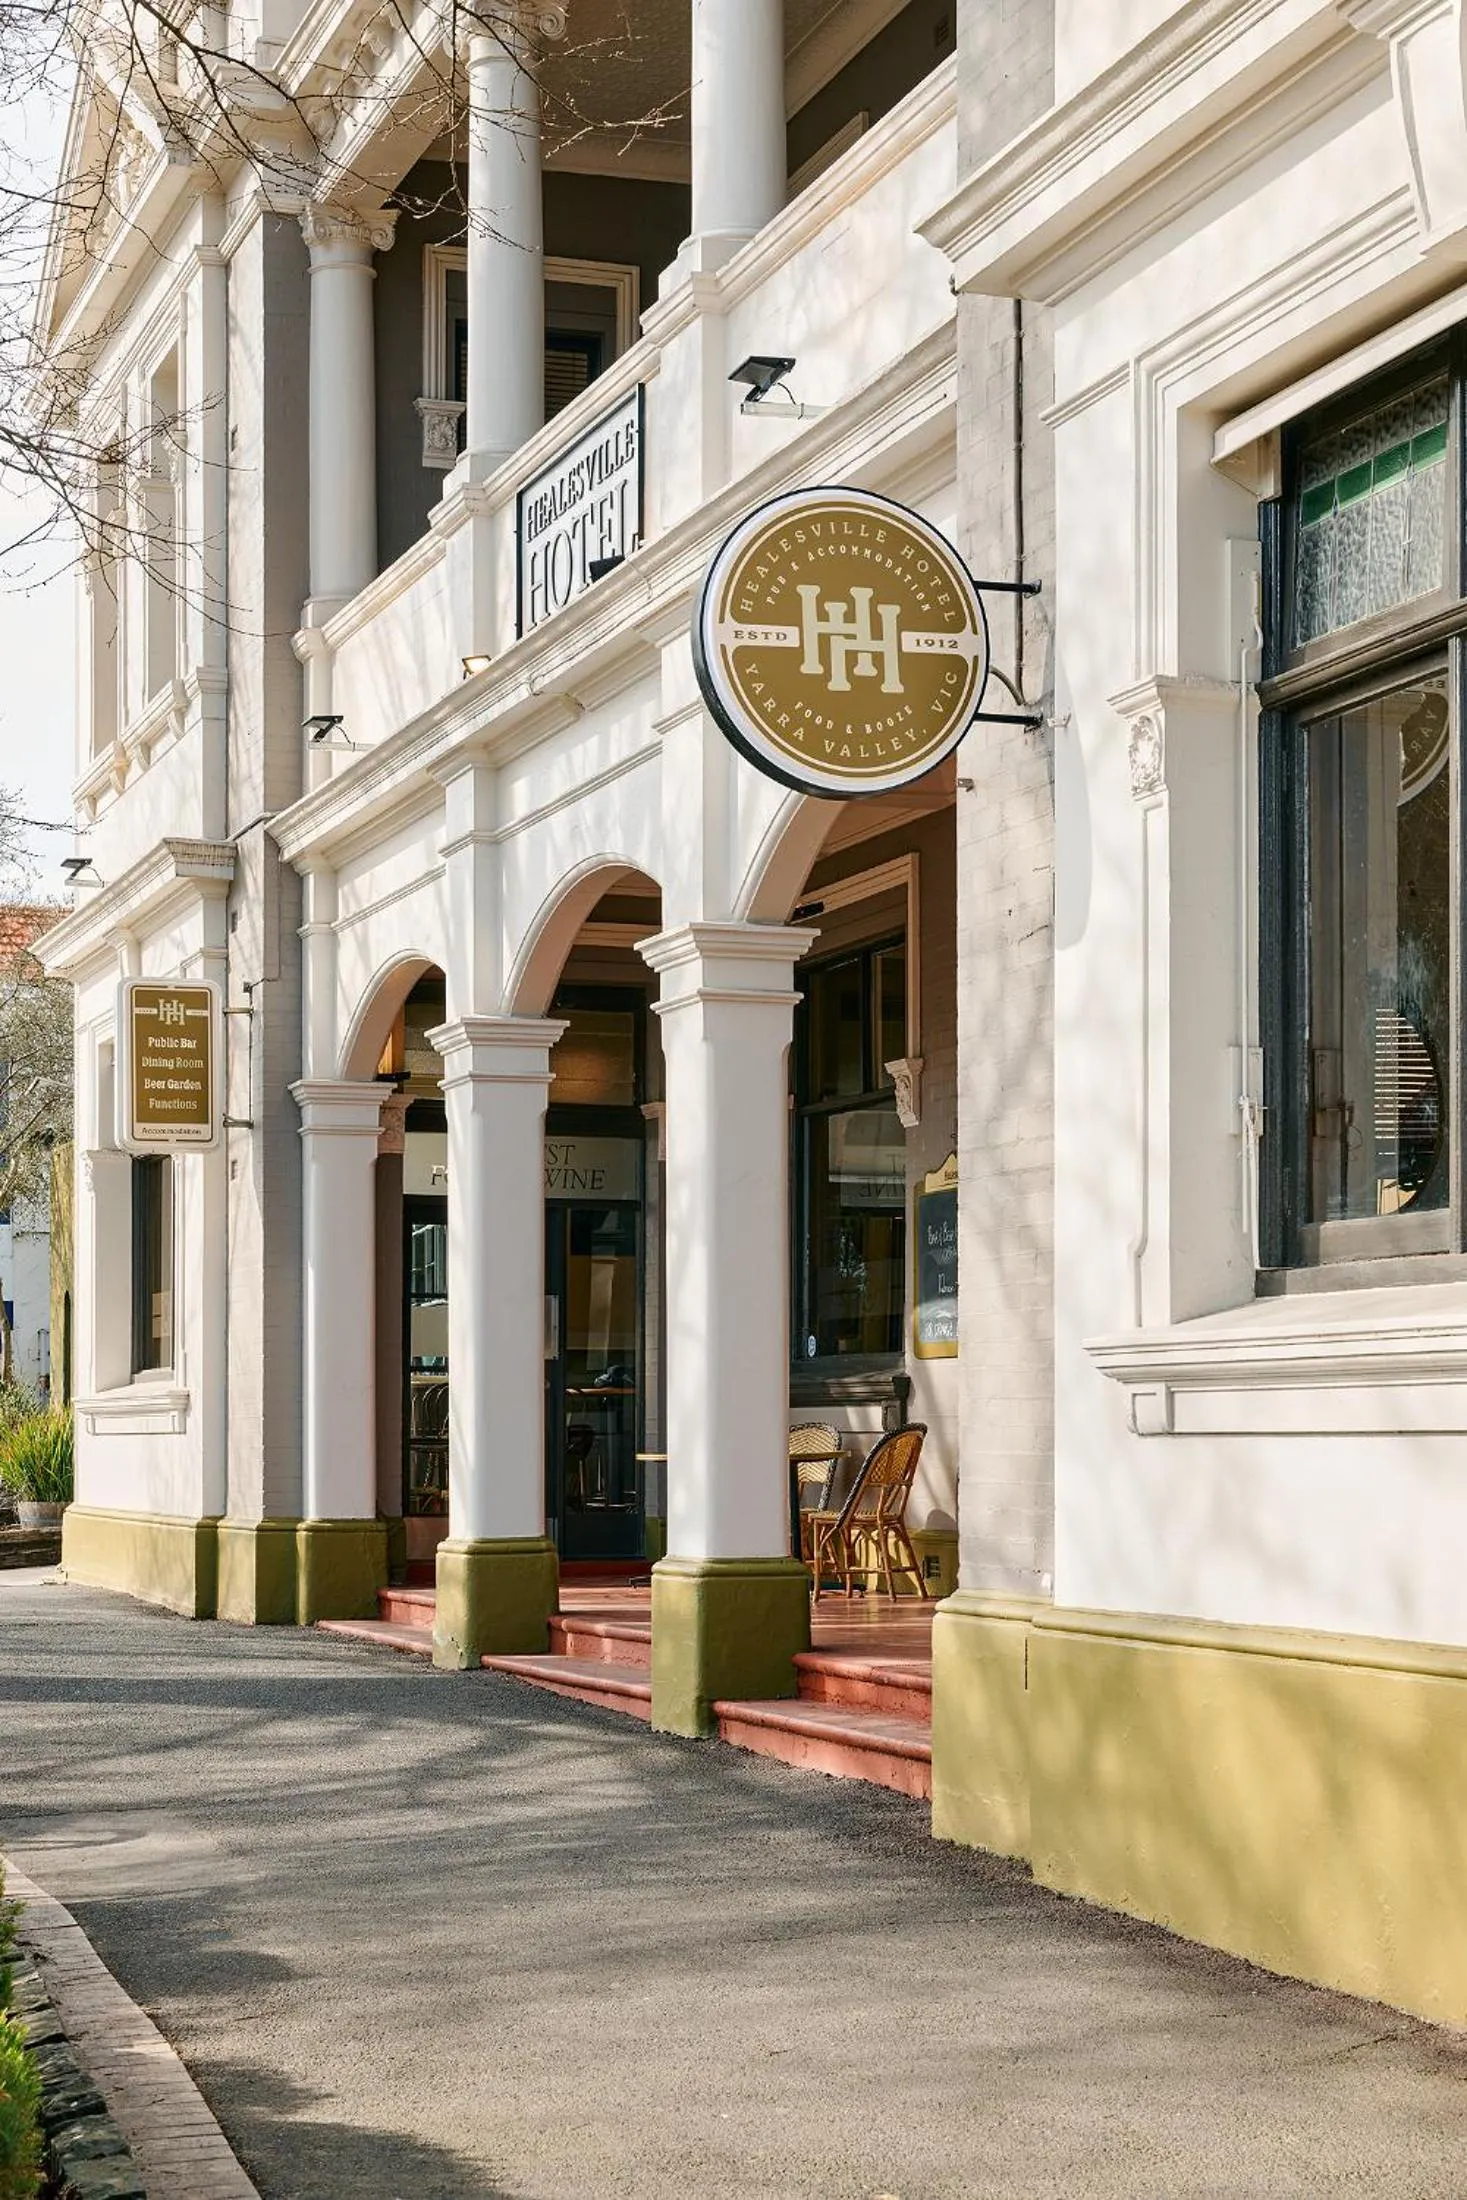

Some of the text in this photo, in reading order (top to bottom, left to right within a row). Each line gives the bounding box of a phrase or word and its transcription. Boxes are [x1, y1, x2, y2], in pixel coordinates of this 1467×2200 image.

[526, 419, 635, 543] HEALESVILLE
[529, 479, 642, 632] HOTEL
[740, 521, 956, 622] HEALESVILLE HOTEL
[766, 576, 787, 605] PUB
[807, 545, 932, 612] ACCOMMODATION
[733, 629, 788, 642] ESTD
[914, 638, 959, 649] 1912
[745, 663, 958, 759] YARRA VALLEY, VIC
[794, 701, 834, 730] FOOD
[864, 704, 913, 734] BOOZE
[147, 1036, 197, 1049] Public Bar
[141, 1056, 204, 1070] Dining Room
[144, 1078, 202, 1091] Beer Garden
[149, 1098, 198, 1110] Functions
